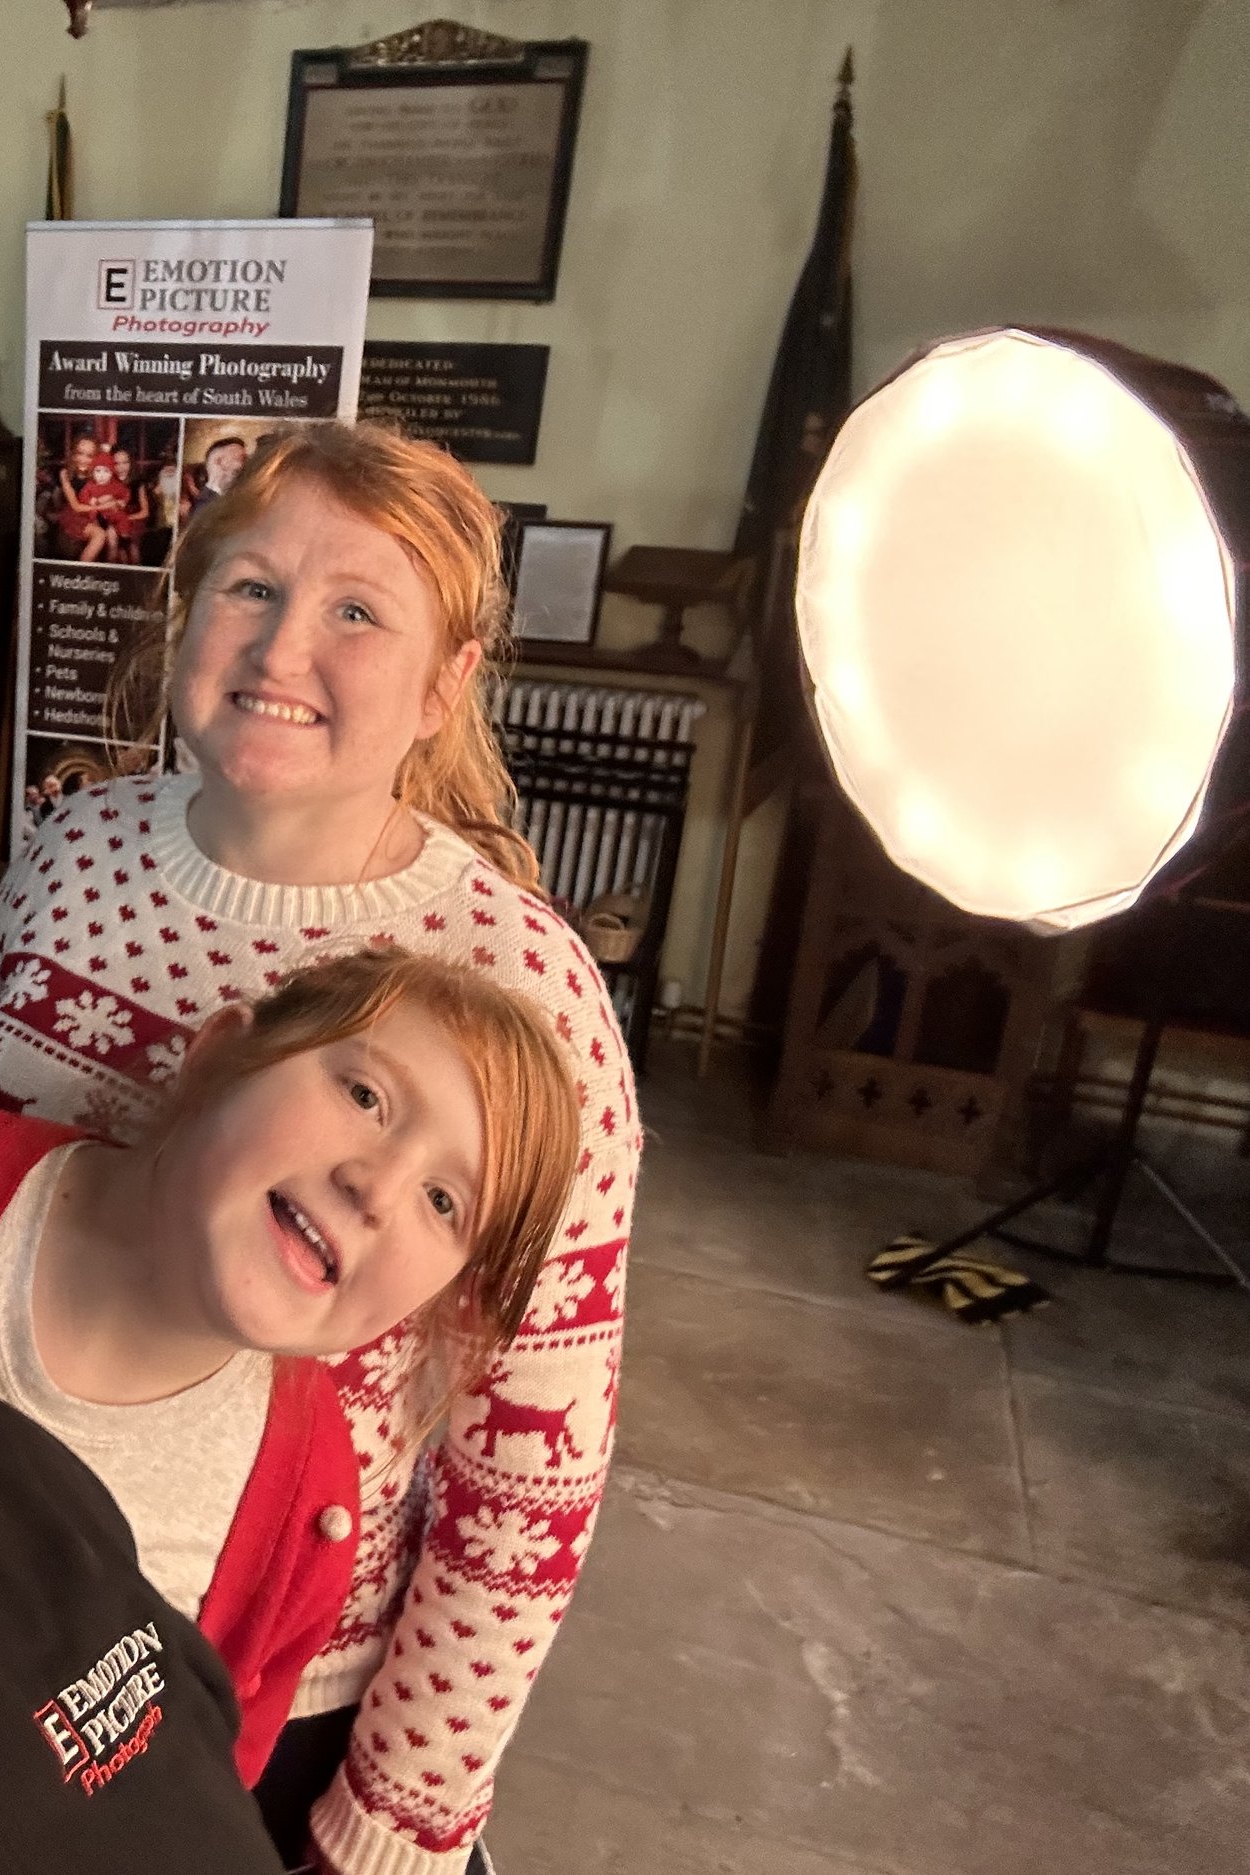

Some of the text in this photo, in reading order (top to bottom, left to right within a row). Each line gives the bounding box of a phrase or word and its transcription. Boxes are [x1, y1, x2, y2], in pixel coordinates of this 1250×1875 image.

[142, 260, 287, 284] EMOTION
[105, 268, 128, 302] E
[139, 288, 272, 312] PICTURE
[112, 315, 271, 337] Photography
[49, 351, 108, 373] Award
[114, 351, 194, 380] Winning
[199, 353, 332, 383] Photography
[64, 384, 309, 409] from the heart of South Wales
[50, 574, 120, 595] Weddings
[49, 599, 95, 619] Family
[97, 603, 107, 617] &
[49, 624, 119, 643] Schools &
[48, 644, 115, 663] Nurseries
[45, 664, 78, 680] Pets
[57, 1621, 163, 1721] EMOTION
[43, 1713, 79, 1765] E
